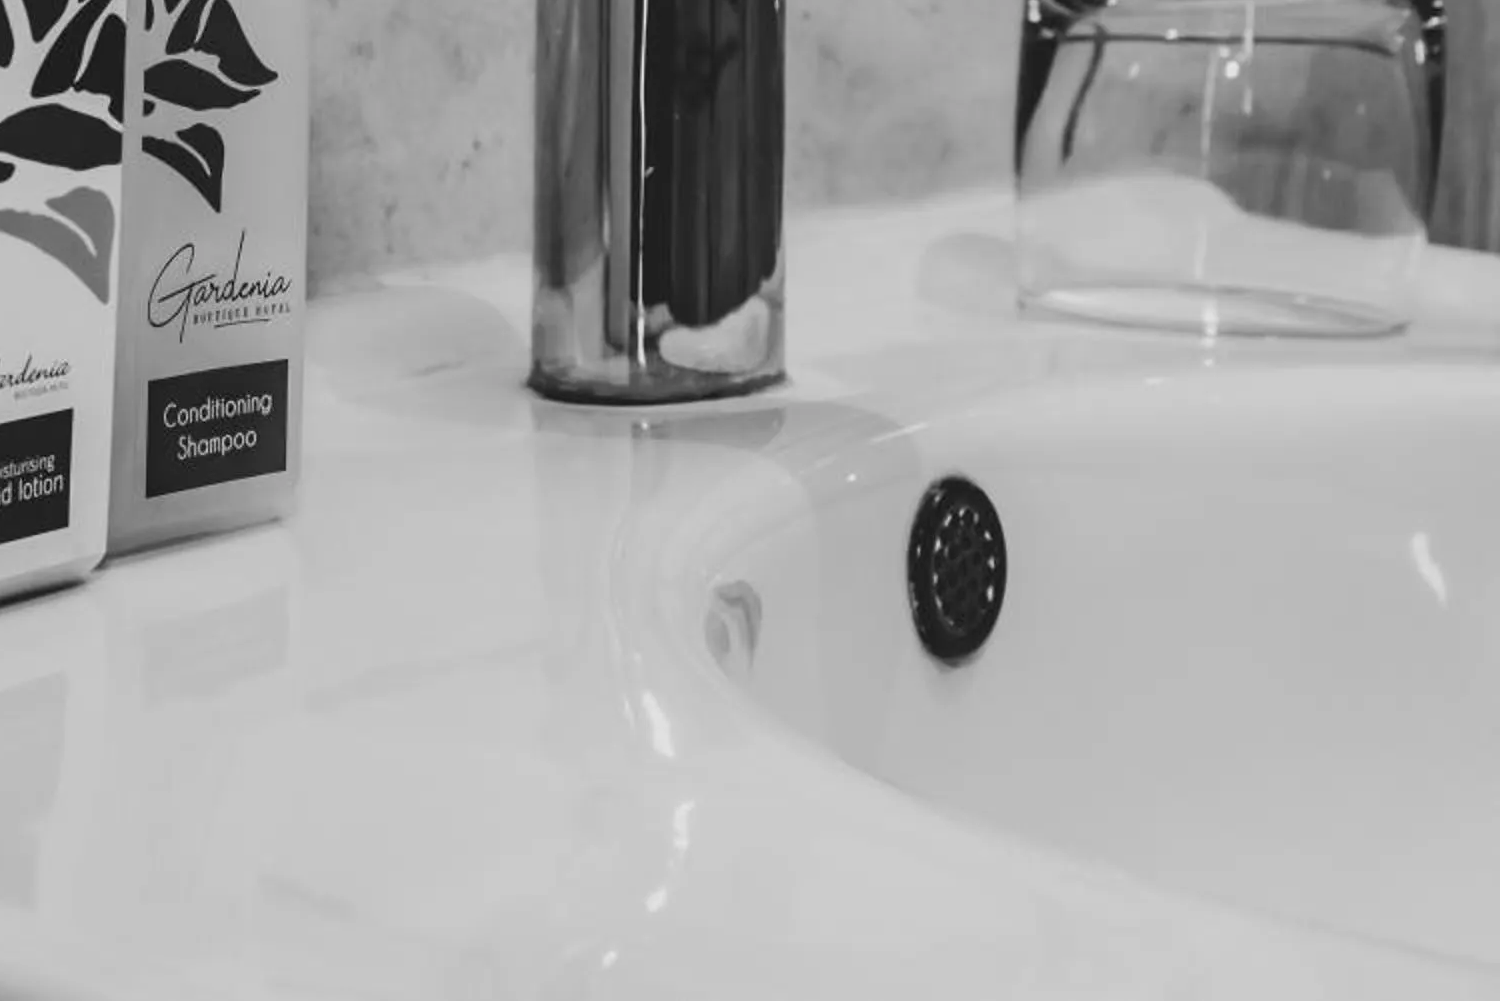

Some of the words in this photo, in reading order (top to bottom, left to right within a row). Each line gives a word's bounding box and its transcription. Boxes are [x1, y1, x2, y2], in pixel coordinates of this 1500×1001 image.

[147, 230, 292, 344] Gardenia
[163, 394, 273, 428] Conditioning
[177, 430, 258, 461] Shampoo
[18, 474, 64, 501] lotion
